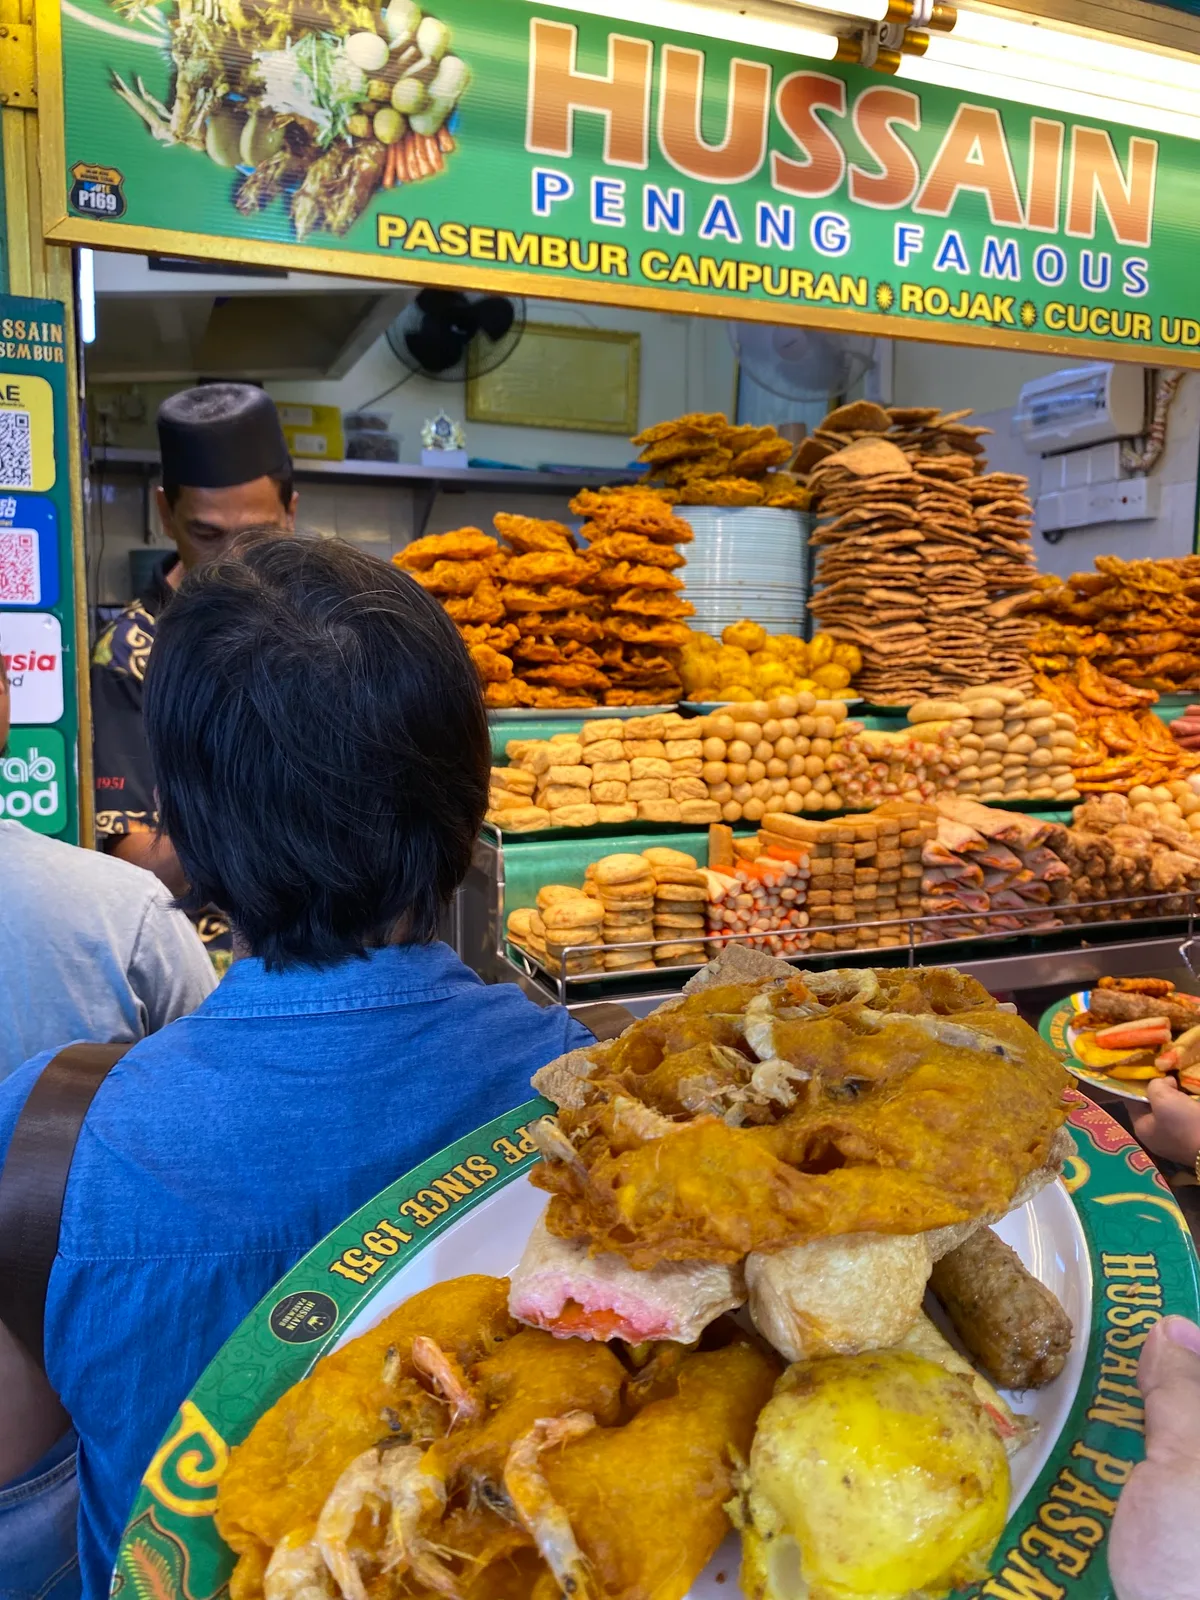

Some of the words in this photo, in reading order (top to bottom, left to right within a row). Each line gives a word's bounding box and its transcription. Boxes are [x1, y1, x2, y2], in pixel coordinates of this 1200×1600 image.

[525, 17, 1158, 248] HUSSAIN
[79, 189, 117, 211] P169
[531, 167, 851, 257] PENANG
[894, 222, 1150, 297] FAMOUS
[377, 213, 629, 276] PASEMBUR
[640, 248, 869, 307] CAMPURAN
[901, 283, 1015, 325] ROJAK
[1044, 302, 1152, 341] CUCUR
[1160, 315, 1200, 346] UD
[96, 776, 125, 790] 1951
[400, 1155, 498, 1227] SINCE
[329, 1219, 412, 1284] 1951
[286, 1300, 316, 1331] HUSSAIN
[1089, 1252, 1164, 1434] HUSSAIN
